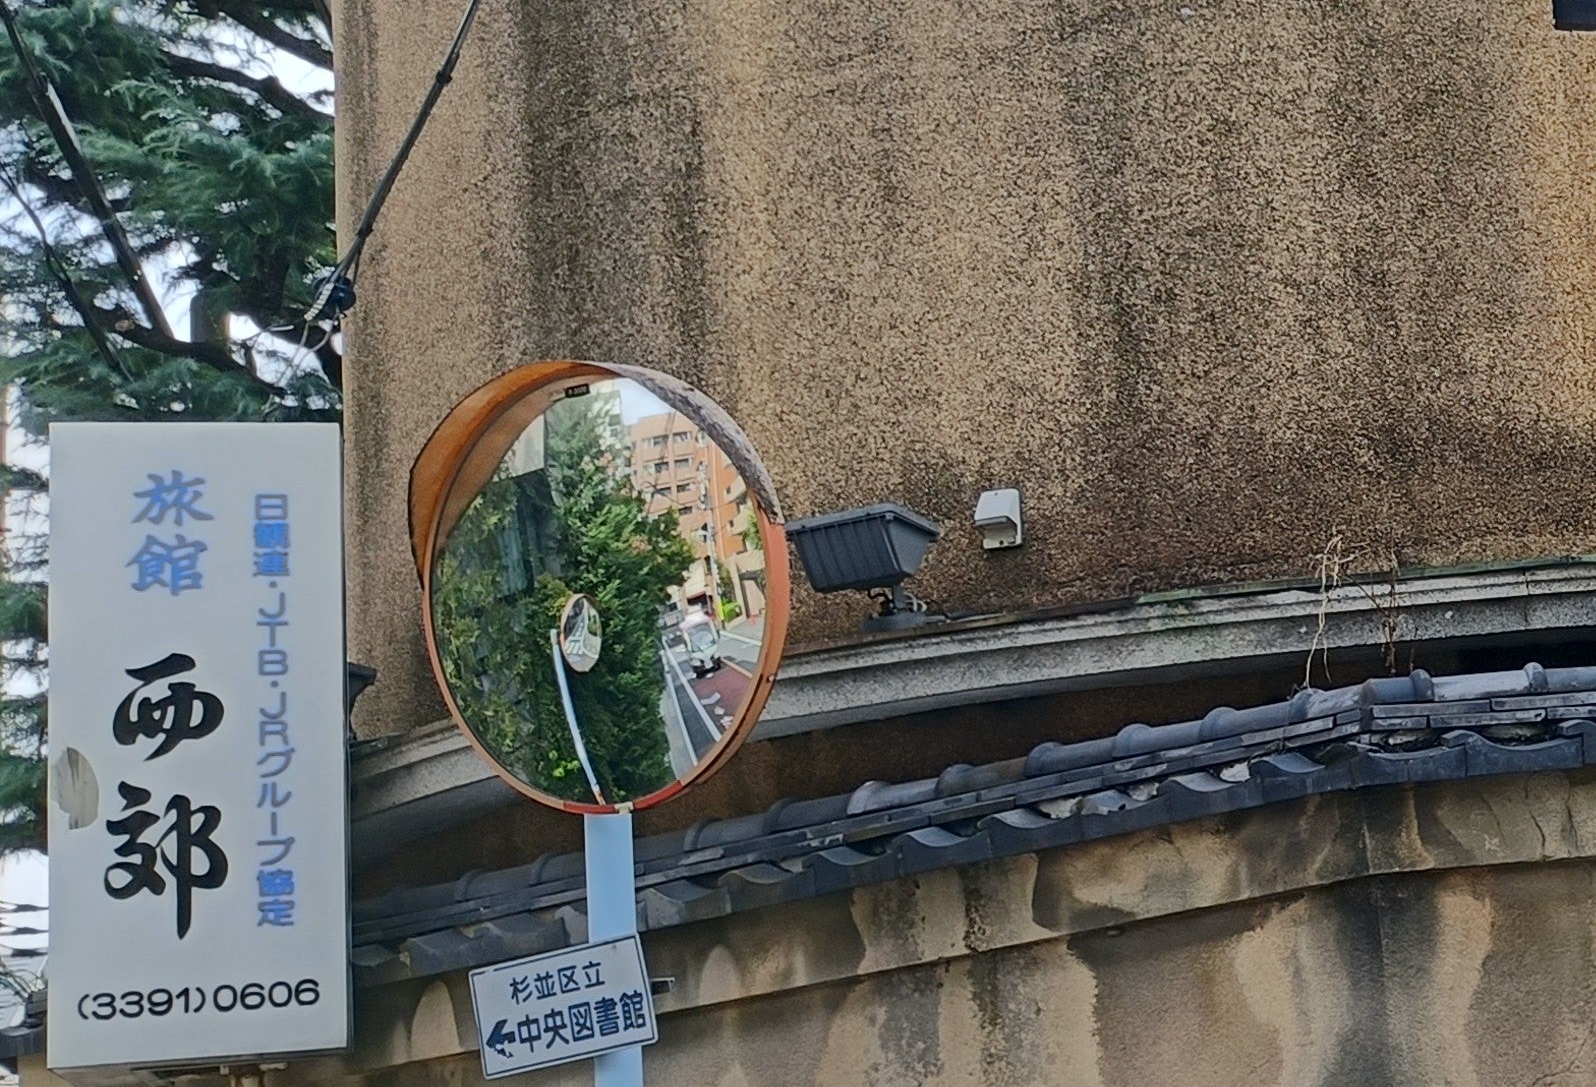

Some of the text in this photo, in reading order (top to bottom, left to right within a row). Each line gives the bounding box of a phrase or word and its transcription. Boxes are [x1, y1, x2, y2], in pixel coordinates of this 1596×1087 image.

[125, 469, 215, 597] 旅館
[103, 652, 229, 940] 西郊
[77, 978, 321, 1021] (3391)0606
[509, 961, 606, 1005] 杉並区立
[517, 989, 647, 1053] 中央図書館
